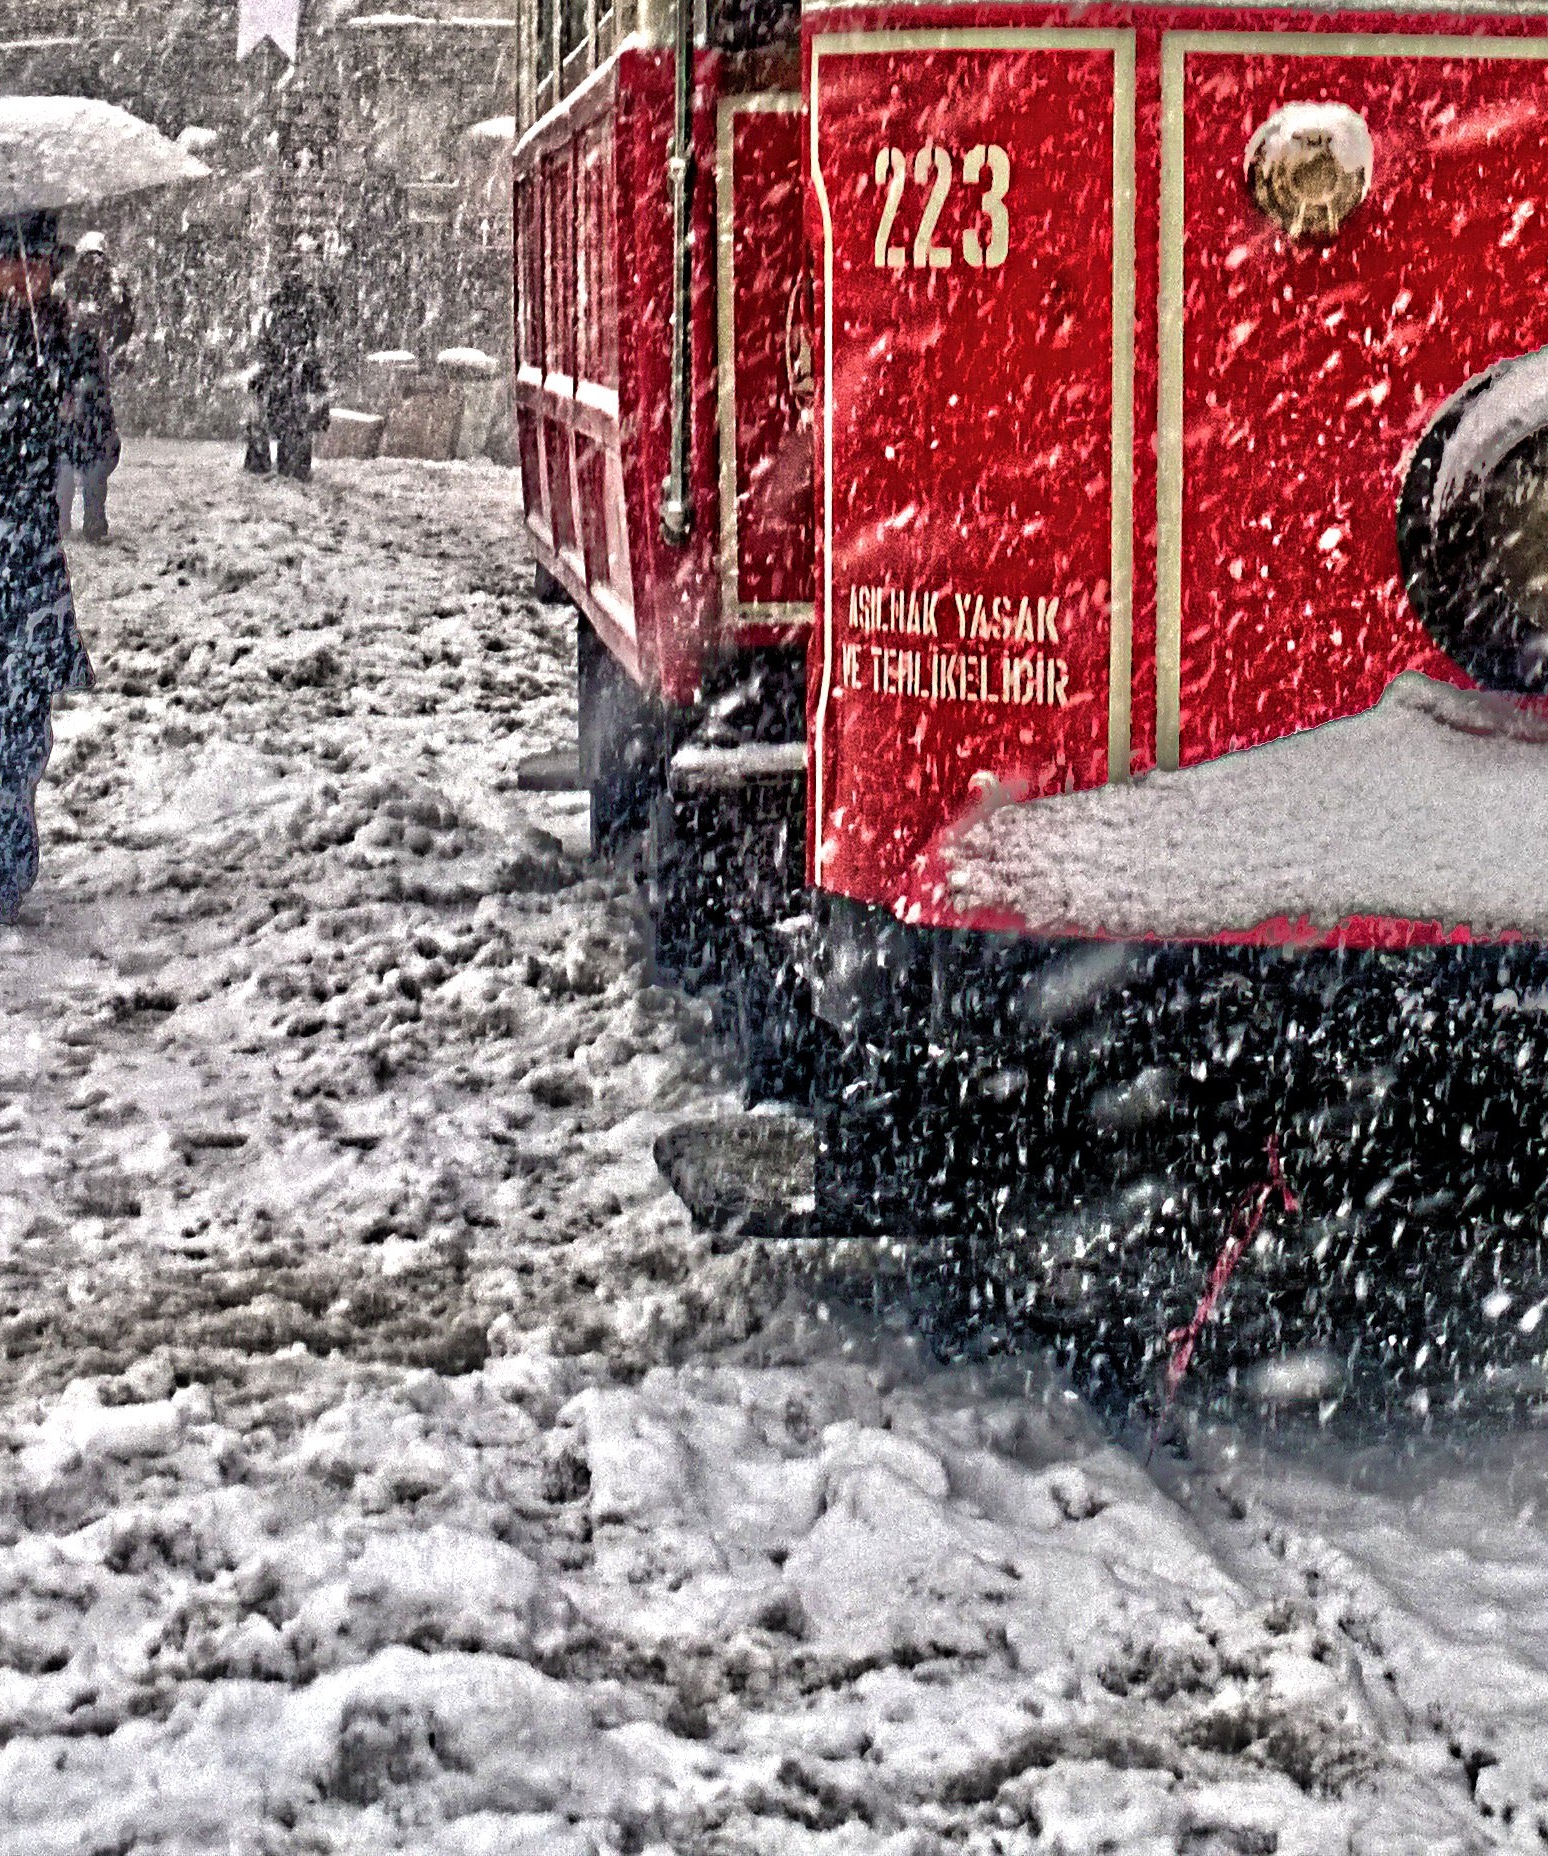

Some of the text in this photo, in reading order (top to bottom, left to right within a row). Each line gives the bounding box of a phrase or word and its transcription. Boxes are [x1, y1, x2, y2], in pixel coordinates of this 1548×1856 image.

[874, 144, 1011, 269] 223
[848, 584, 1060, 644] ASILMAK YASAK
[841, 643, 863, 690] VE
